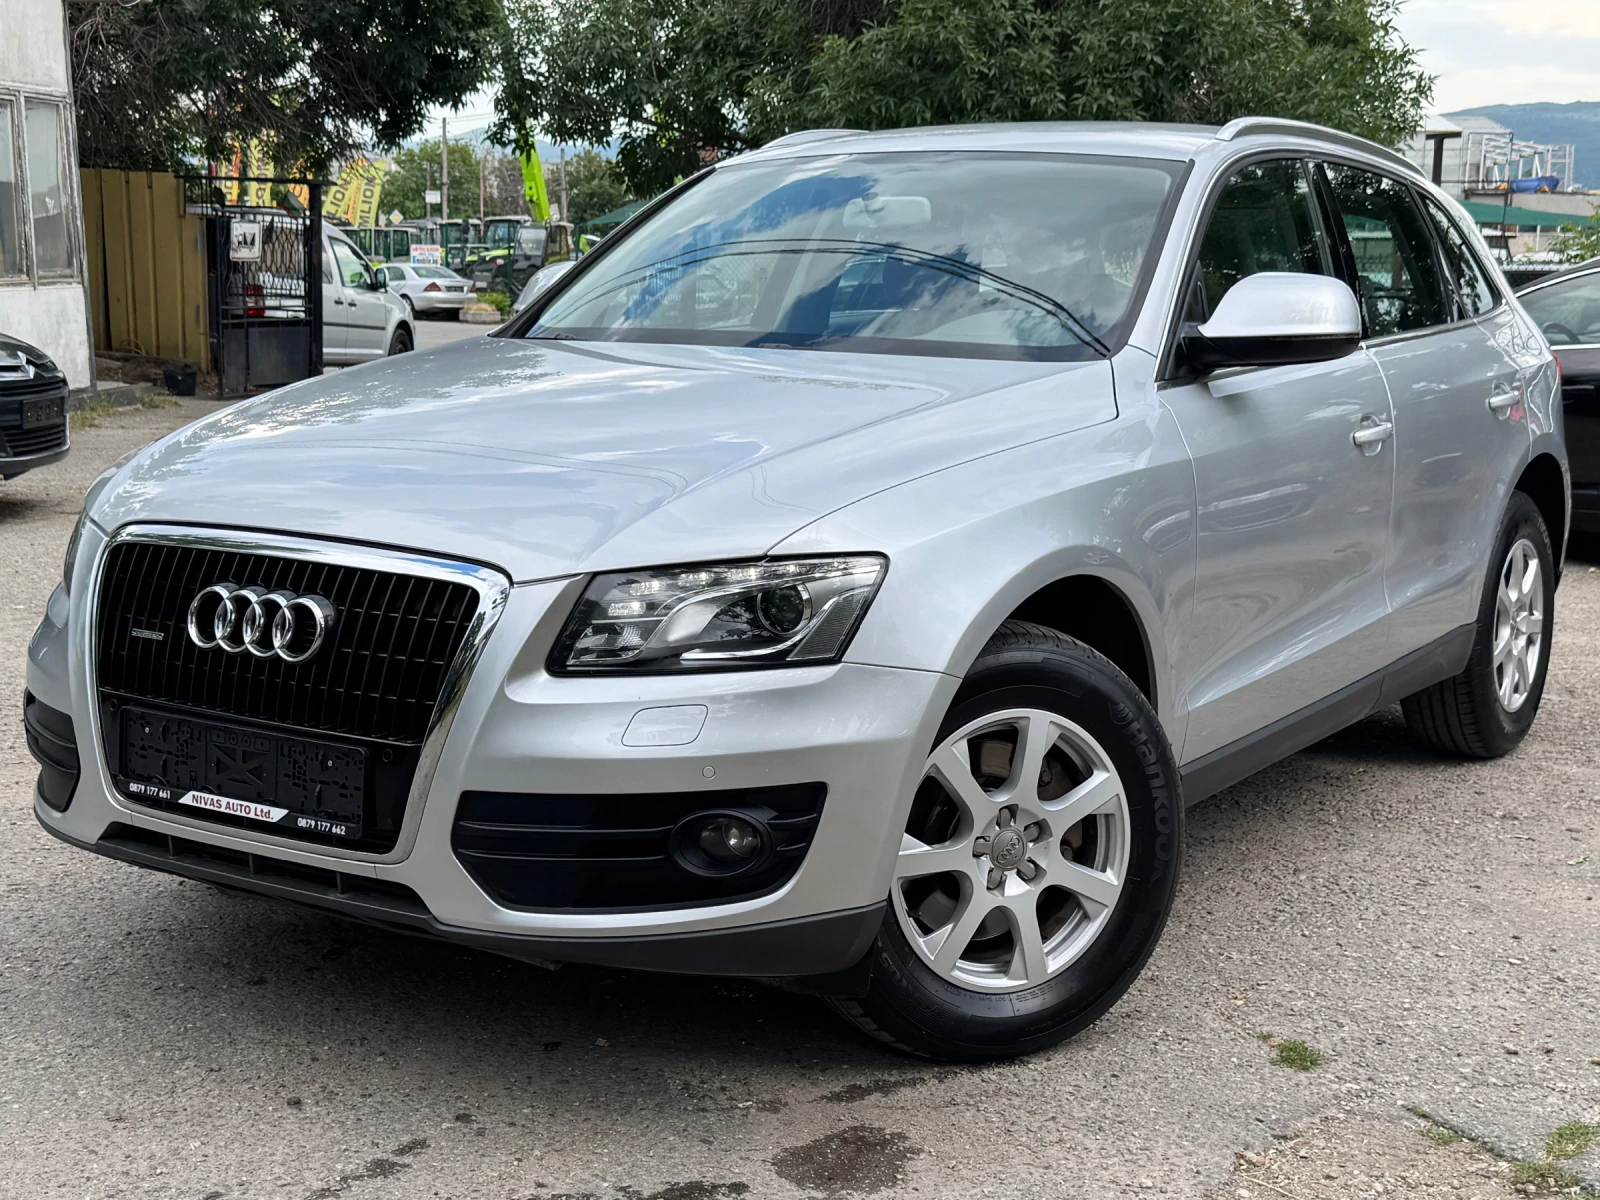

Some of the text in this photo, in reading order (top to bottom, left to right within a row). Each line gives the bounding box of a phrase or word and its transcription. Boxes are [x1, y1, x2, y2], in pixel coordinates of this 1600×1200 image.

[129, 782, 171, 800] 0879 177 661
[191, 793, 275, 821] NIVAS AUTO Ltd.
[297, 817, 346, 836] 0879 177 662
